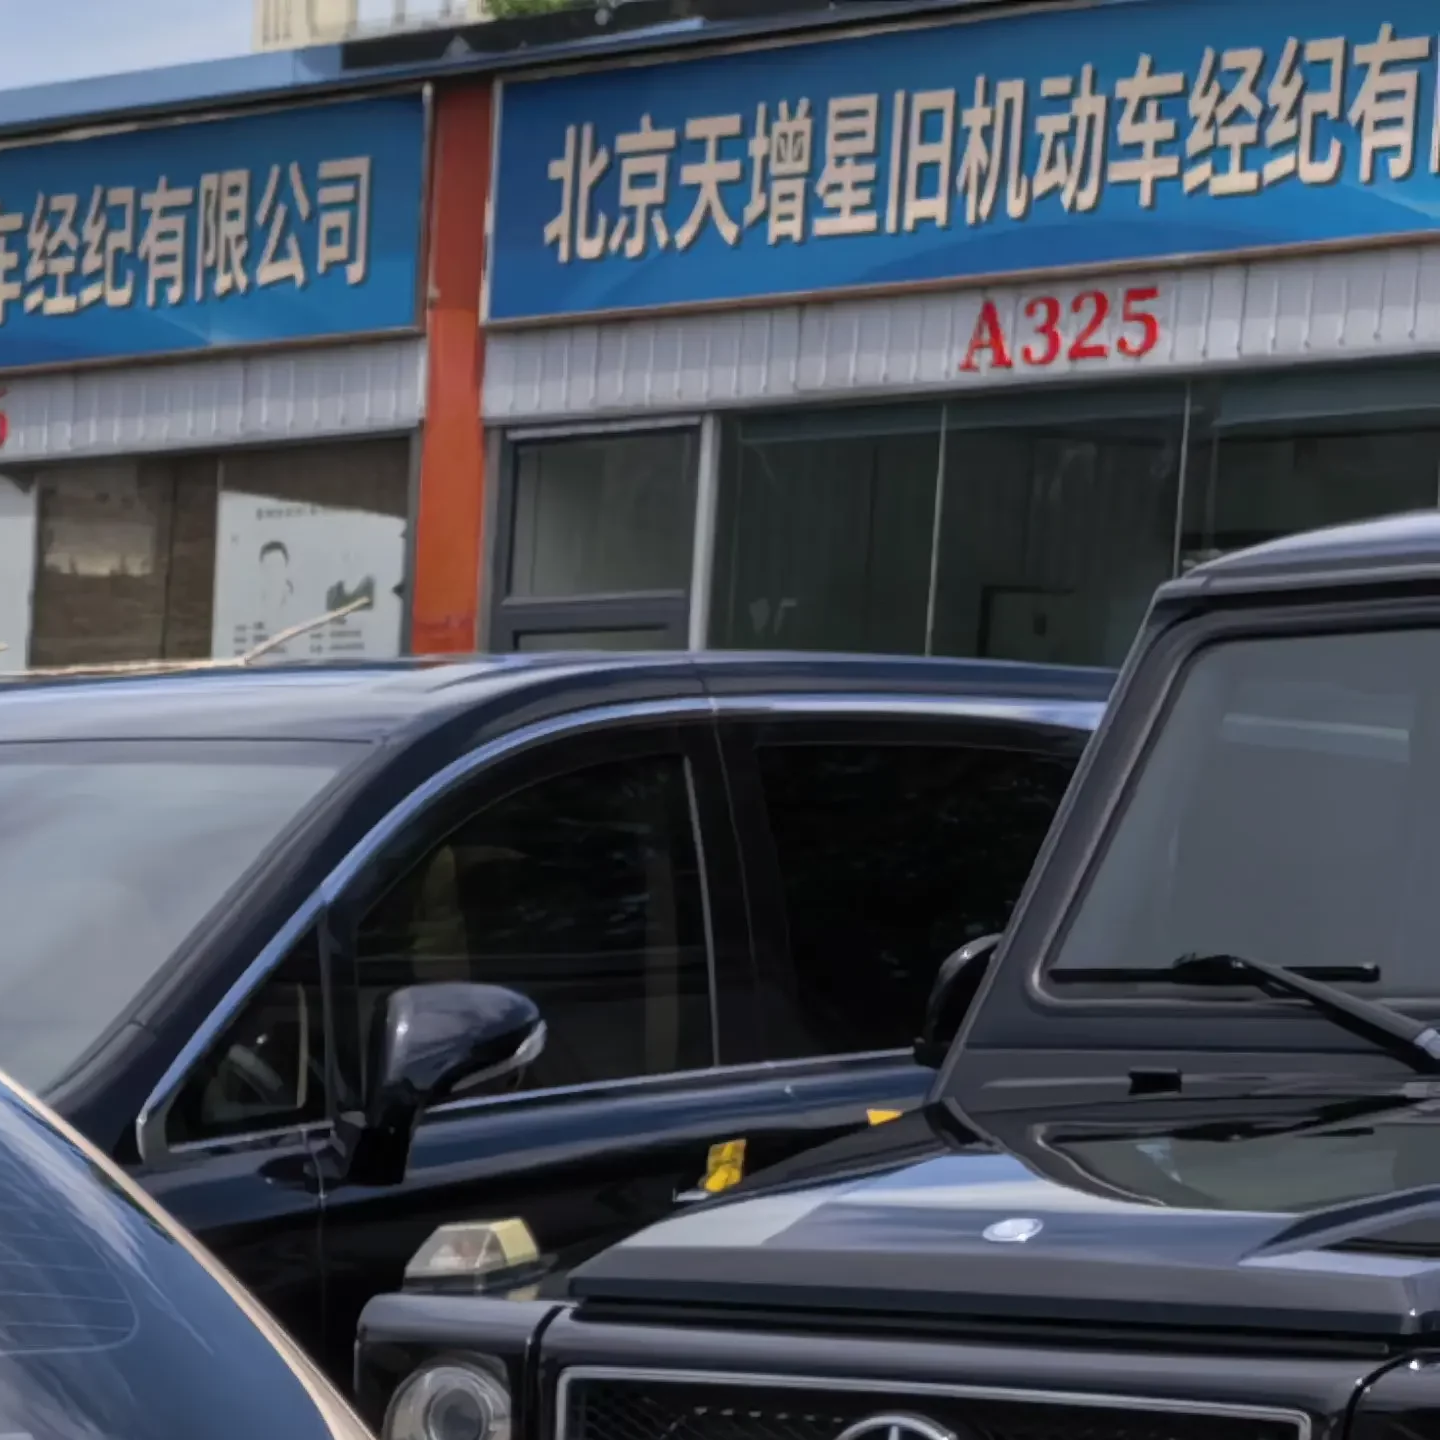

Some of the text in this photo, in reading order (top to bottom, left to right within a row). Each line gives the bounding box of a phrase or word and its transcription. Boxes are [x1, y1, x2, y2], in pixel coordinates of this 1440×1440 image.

[543, 22, 1440, 264] 北京天增星旧机动车经纪有
[958, 286, 1162, 371] A325
